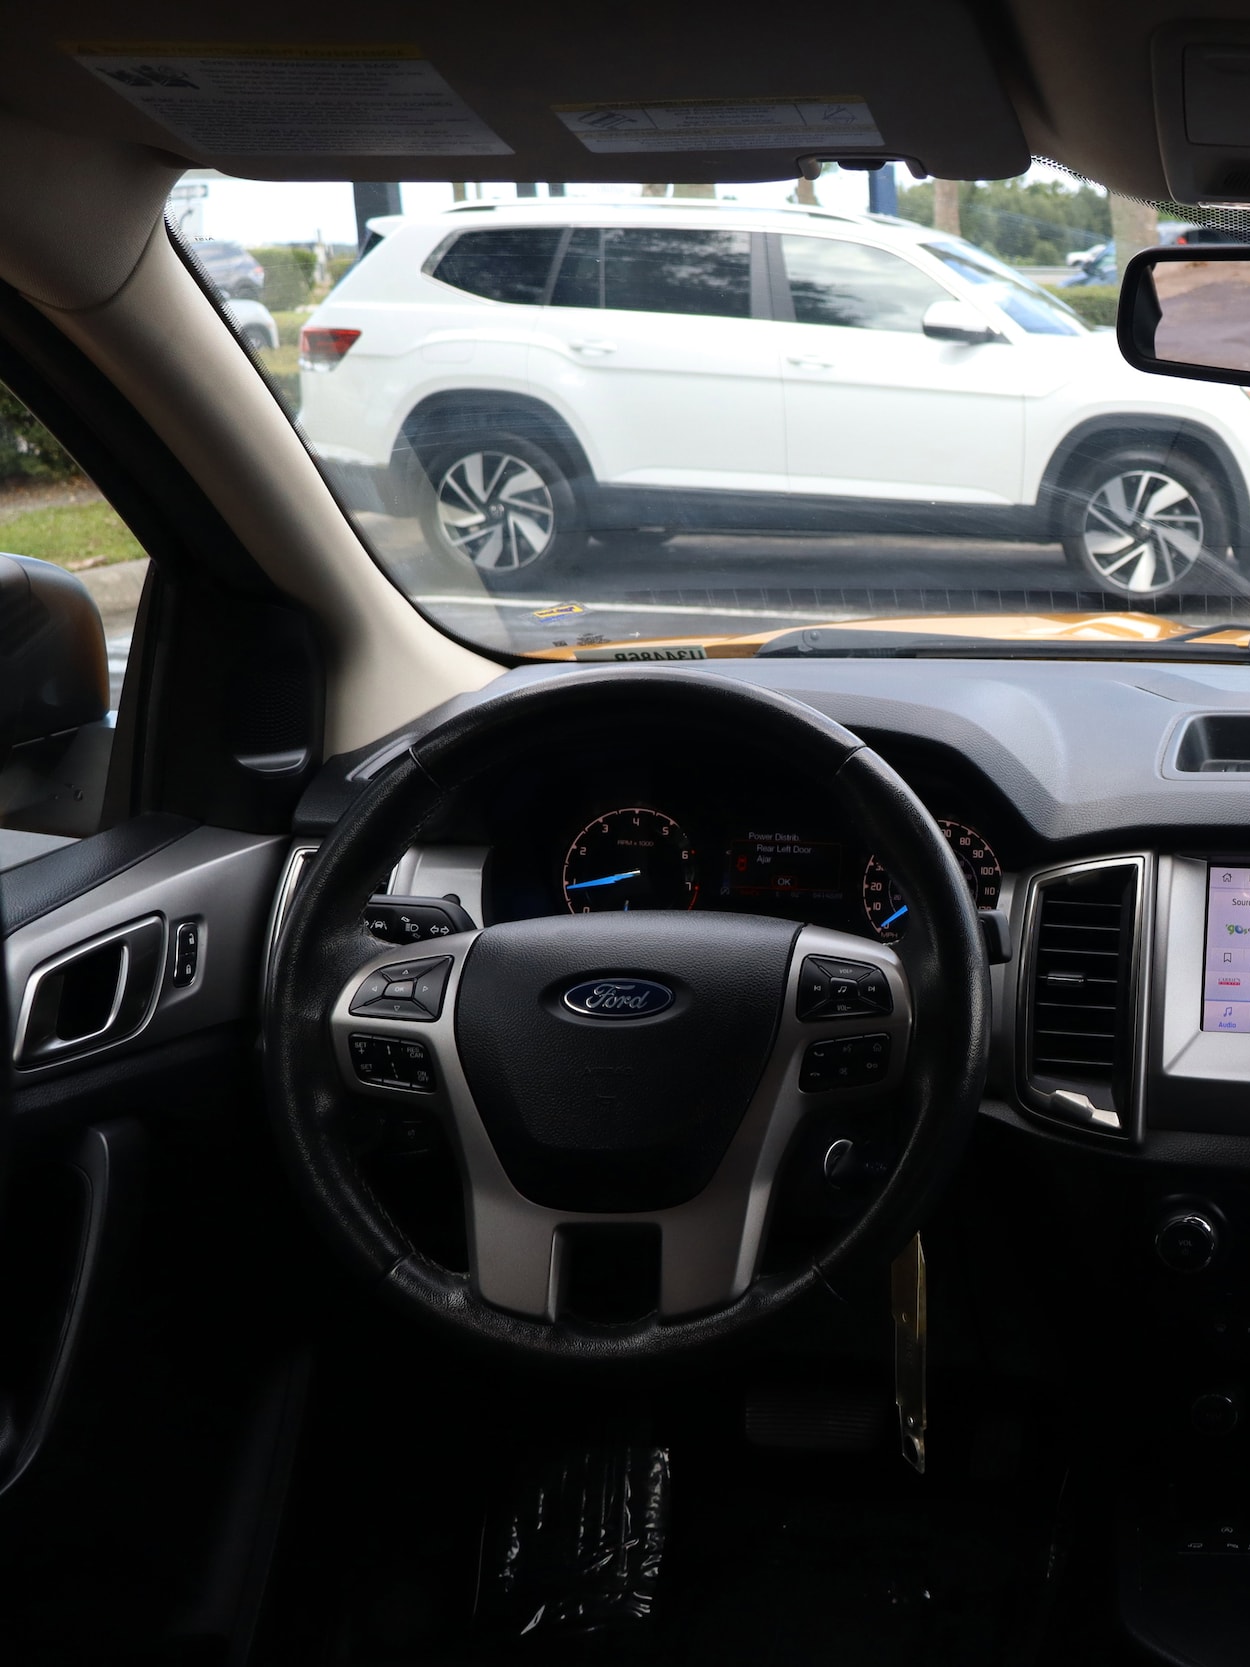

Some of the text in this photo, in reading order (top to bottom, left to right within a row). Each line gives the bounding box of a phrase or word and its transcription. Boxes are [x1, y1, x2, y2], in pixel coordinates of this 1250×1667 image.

[633, 817, 640, 826] 4
[602, 825, 609, 833] 3
[662, 827, 669, 835] 5
[748, 832, 773, 841] Power
[960, 837, 970, 846] 80
[579, 847, 586, 855] 2
[756, 844, 812, 854] Rear Left Door
[682, 851, 688, 859] 6
[972, 850, 984, 859] 90
[756, 855, 772, 864] Ajar
[981, 867, 994, 876] 100
[685, 882, 691, 891] 7
[870, 882, 882, 891] 20
[984, 887, 996, 896] 110
[873, 902, 881, 911] 10
[585, 983, 651, 1009] Ford
